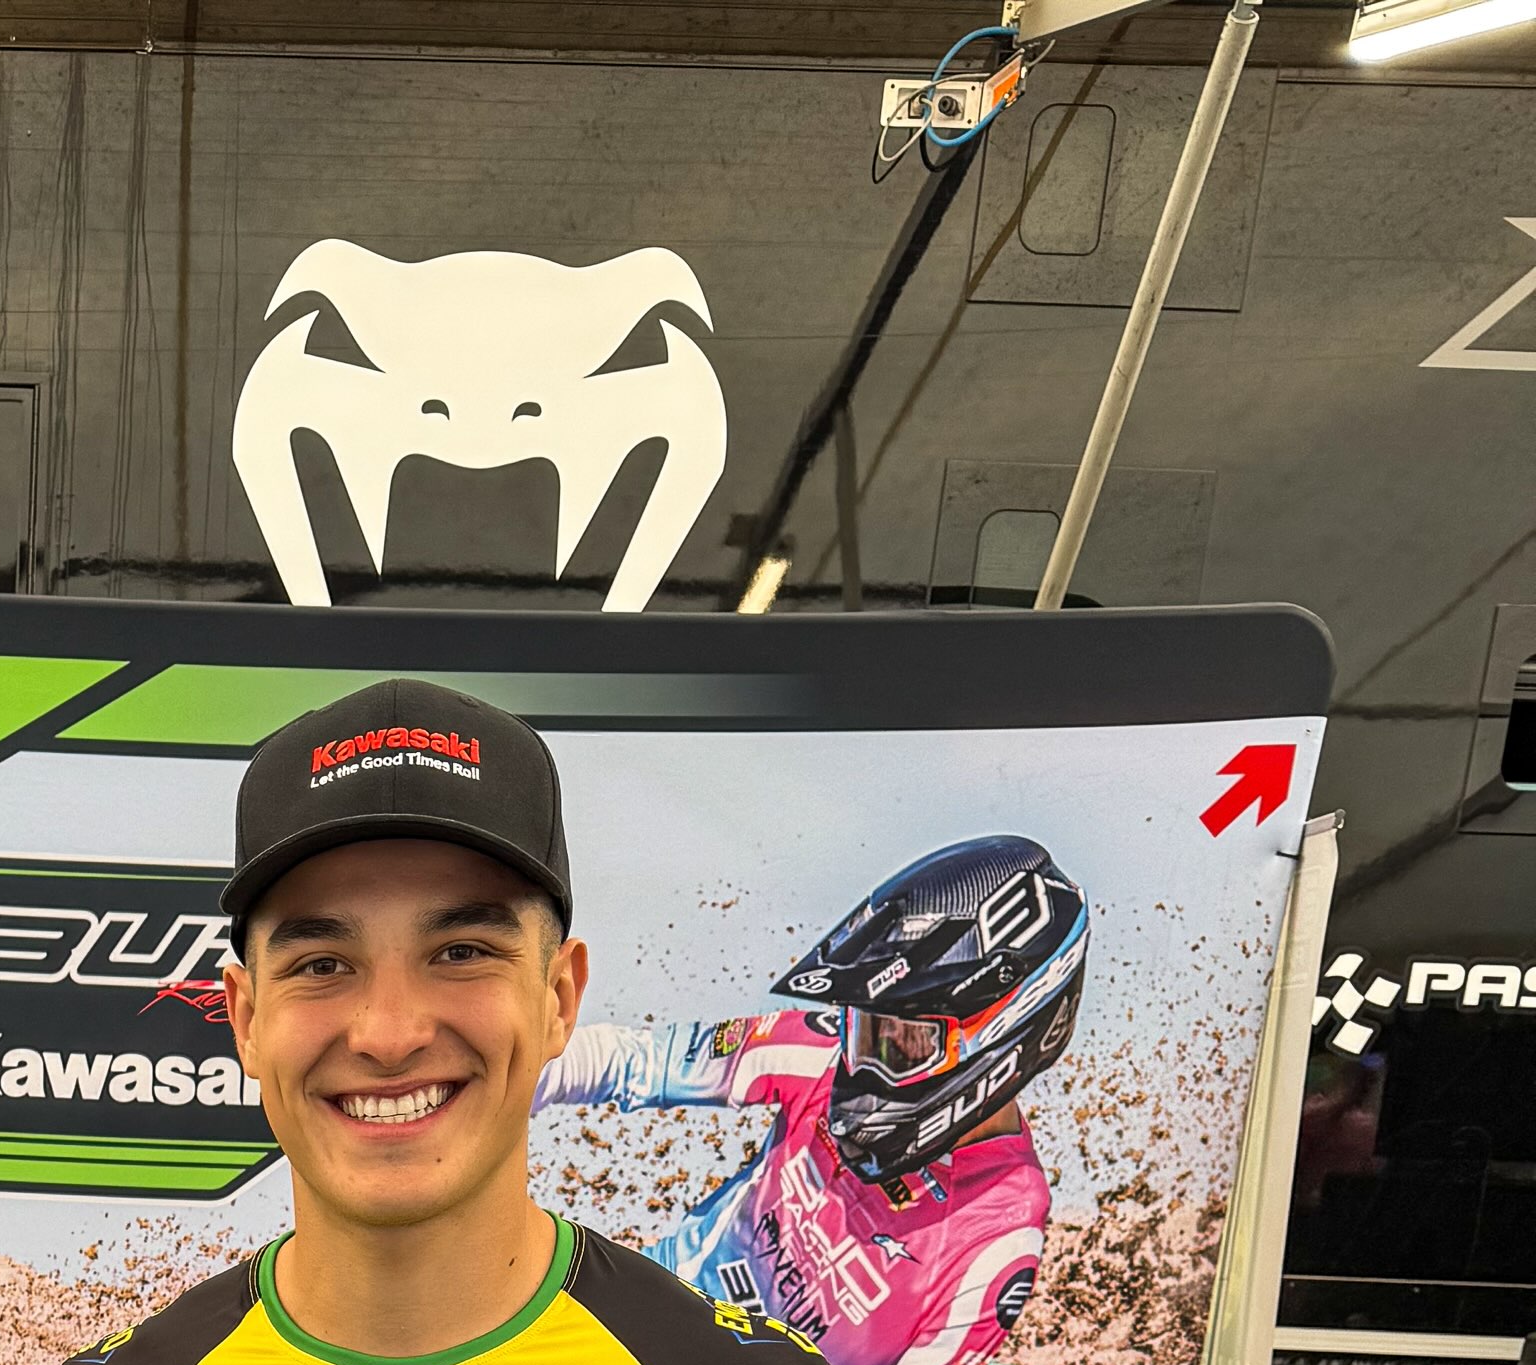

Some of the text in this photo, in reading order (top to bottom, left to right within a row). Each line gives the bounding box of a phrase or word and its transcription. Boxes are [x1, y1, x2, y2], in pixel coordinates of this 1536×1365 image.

[310, 751, 480, 788] Let the Good Times Roll
[311, 727, 481, 773] Kawasaki
